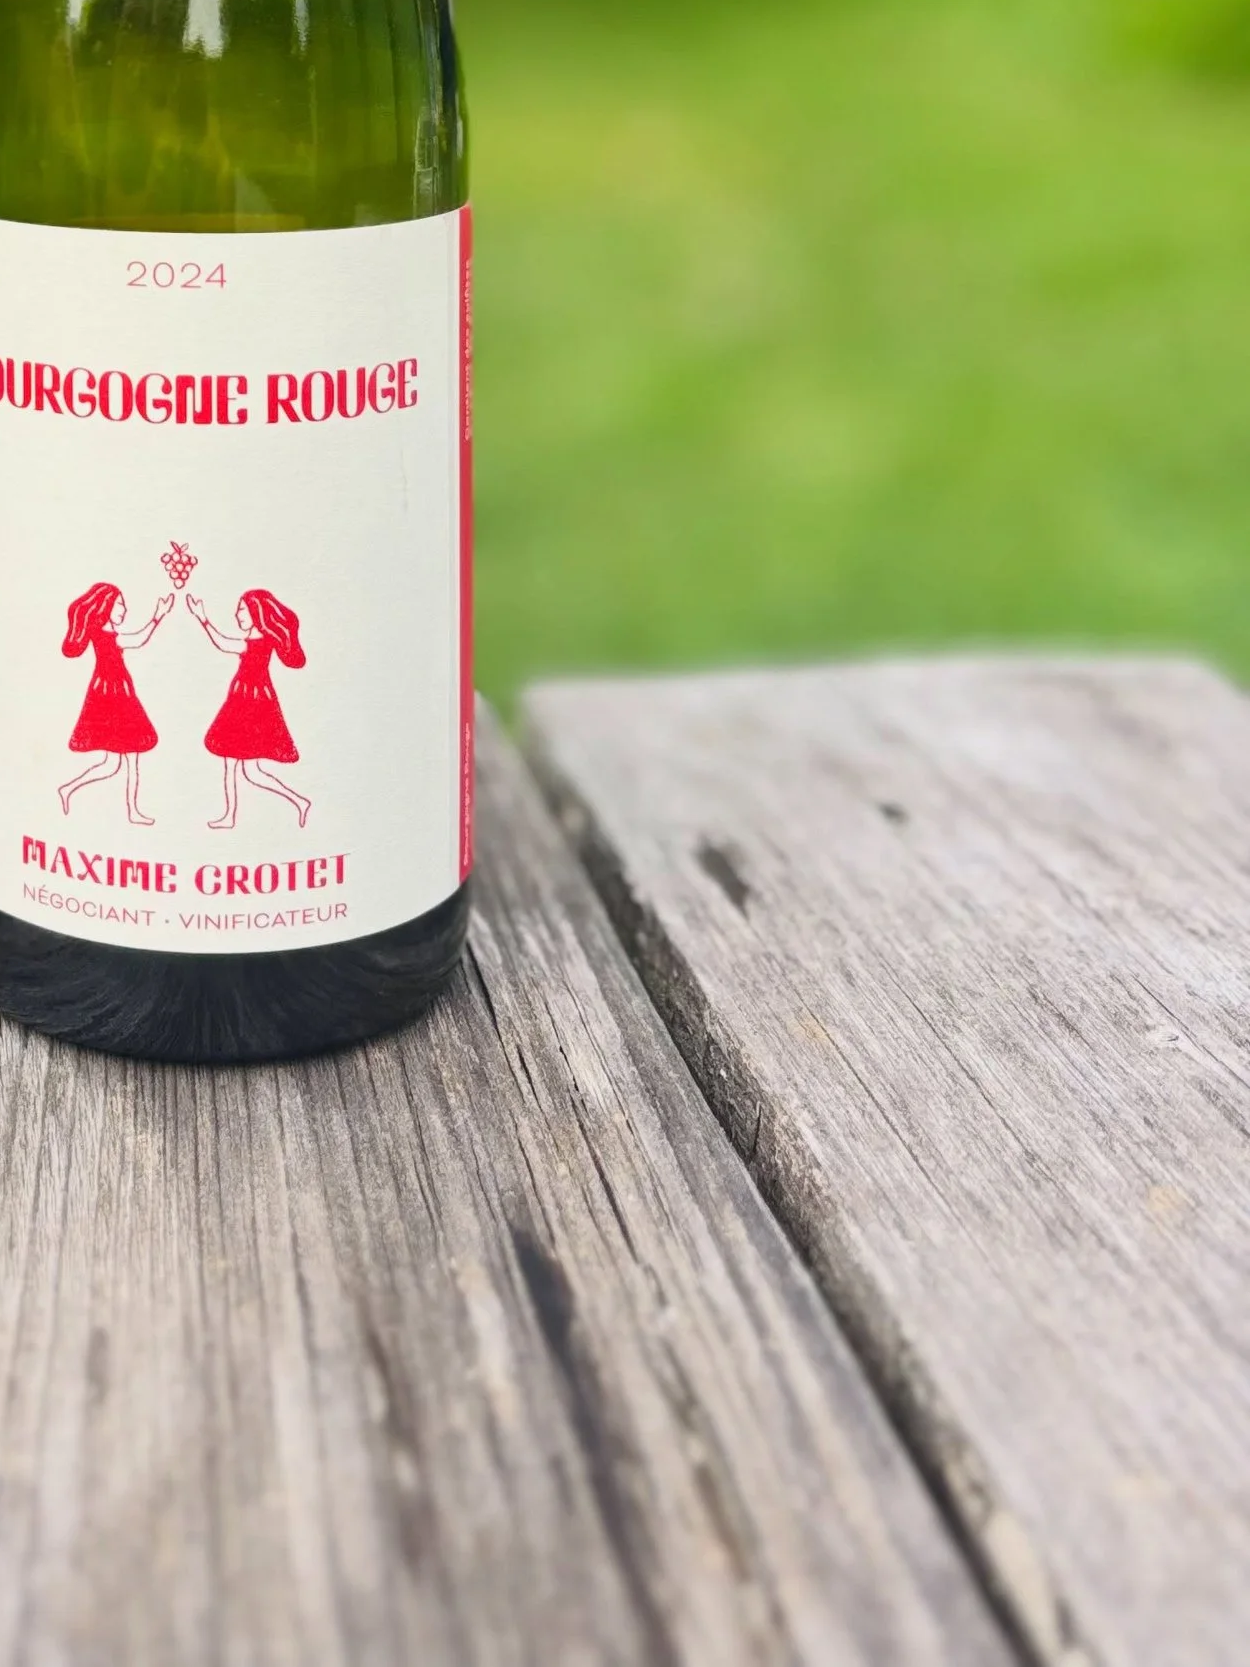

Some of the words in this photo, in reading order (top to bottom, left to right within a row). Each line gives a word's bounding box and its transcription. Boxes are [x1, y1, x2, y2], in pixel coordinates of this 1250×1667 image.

[126, 261, 227, 289] 2024
[265, 357, 420, 426] ROUGE
[21, 834, 178, 894] MAXIME
[22, 882, 156, 928] NÉGOCIANT
[178, 901, 350, 931] VINIFICATEUR
